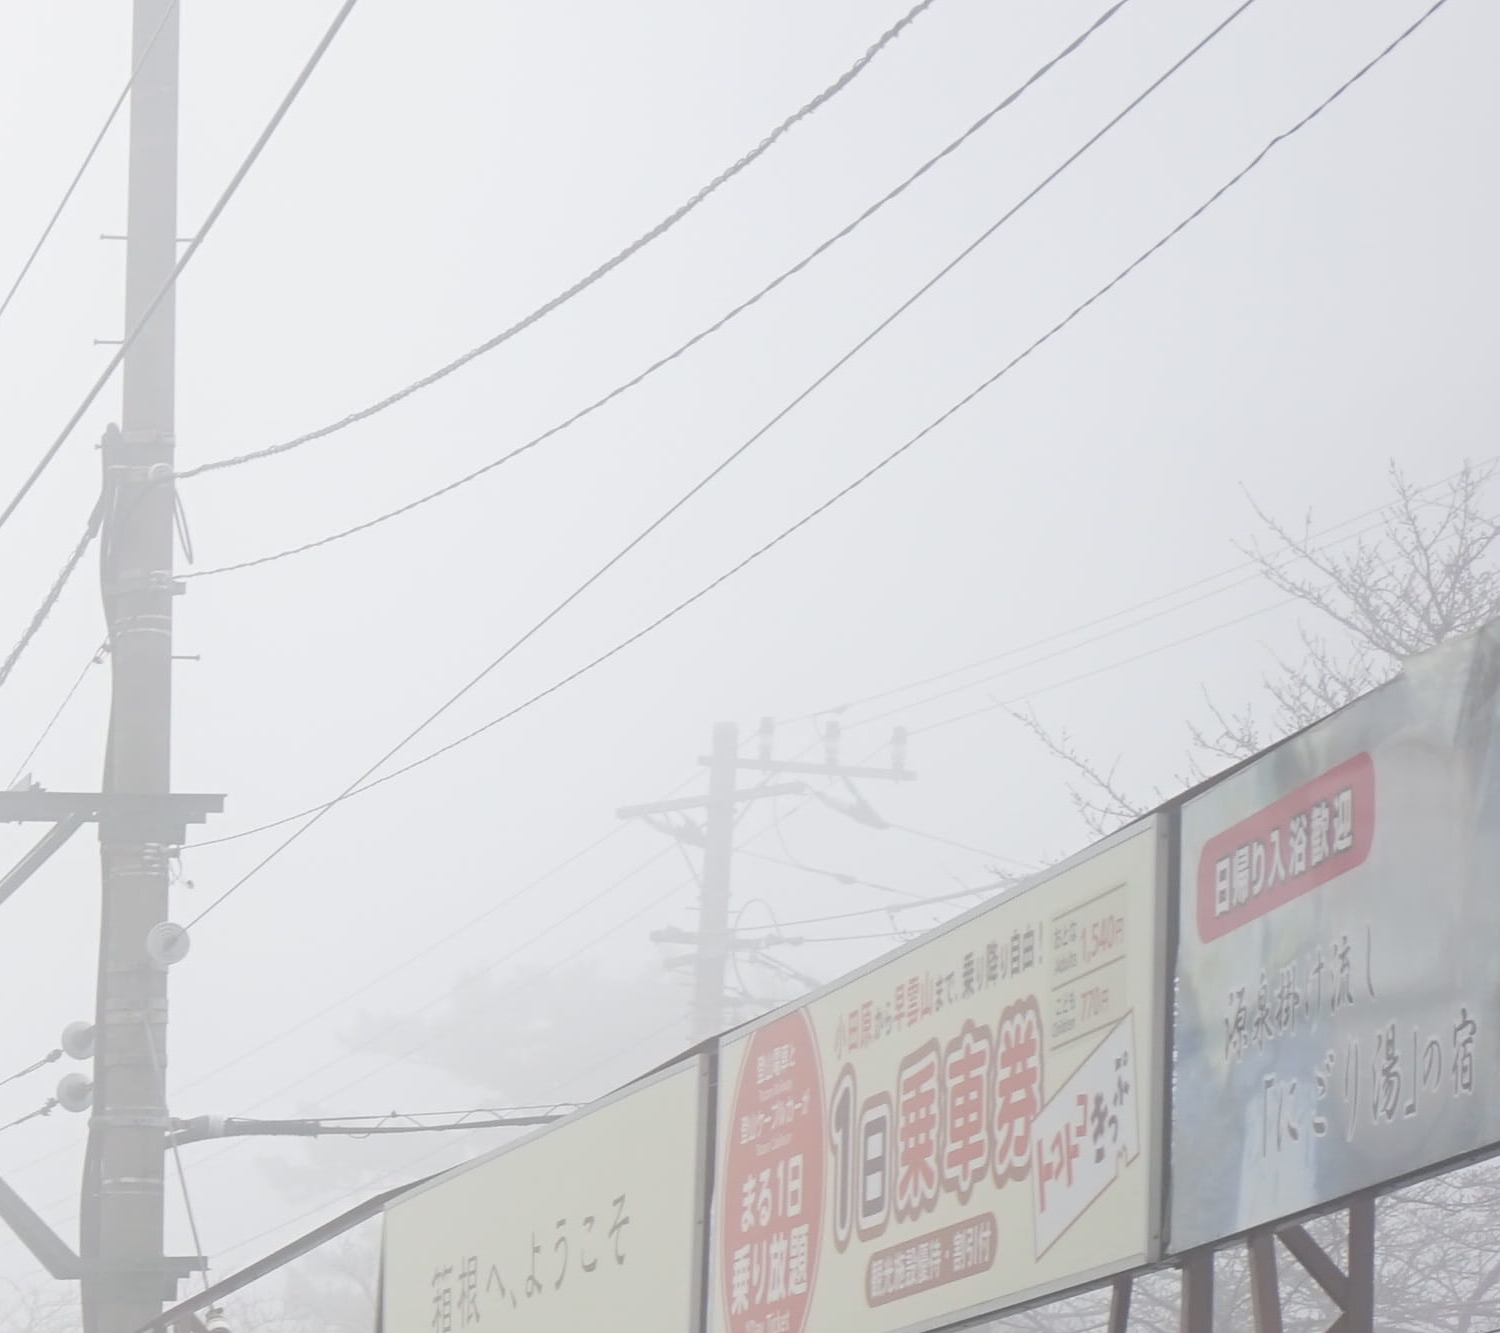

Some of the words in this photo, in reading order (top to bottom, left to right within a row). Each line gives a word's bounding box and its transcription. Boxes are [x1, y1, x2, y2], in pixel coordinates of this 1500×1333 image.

[1222, 921, 1377, 1064] 源泉掛け流し
[832, 1000, 1042, 1250] 1日乗車券
[1262, 1006, 1479, 1160] 「にごり湯」の宿
[741, 1152, 804, 1234] まる1日
[731, 1222, 810, 1317] 乗り放題
